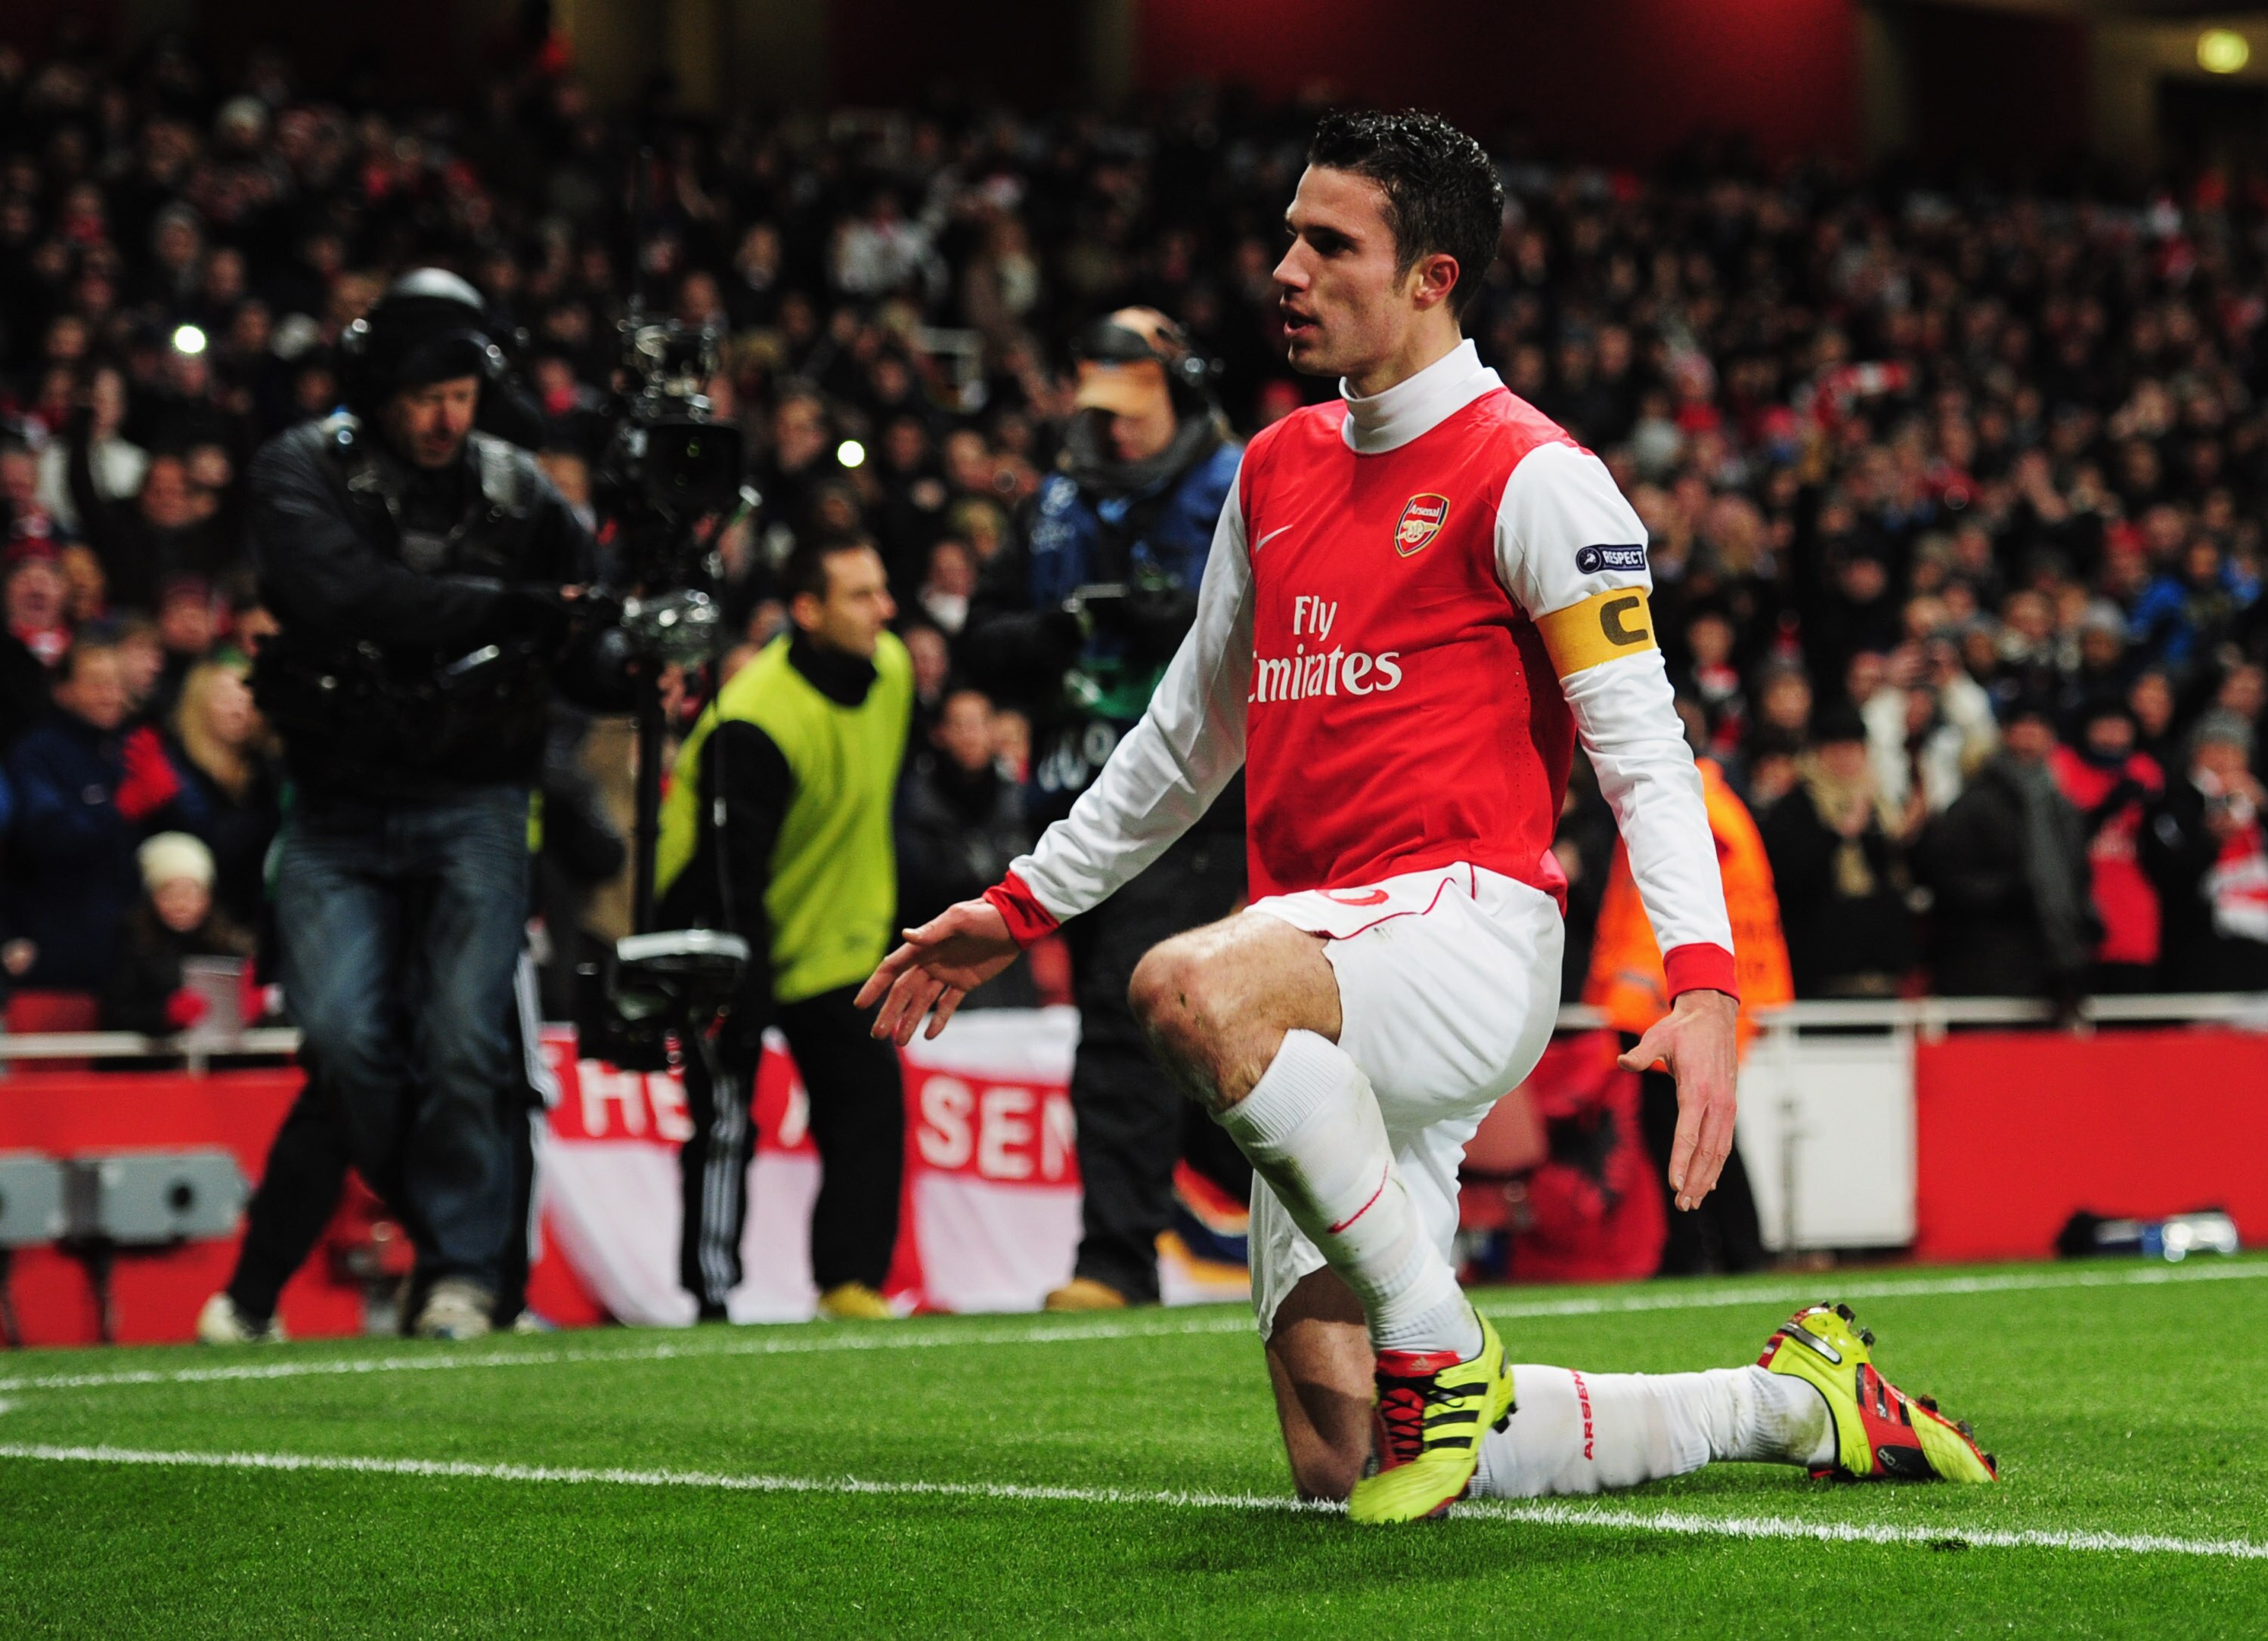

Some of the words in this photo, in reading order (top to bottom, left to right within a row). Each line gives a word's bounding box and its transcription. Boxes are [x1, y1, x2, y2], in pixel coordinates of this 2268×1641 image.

[1408, 504, 1440, 517] Arsenal
[1603, 550, 1644, 565] RESPECT
[1294, 596, 1337, 641] Fly
[1600, 596, 1649, 646] C
[1248, 643, 1402, 703] mirates
[576, 1058, 696, 1142] HE
